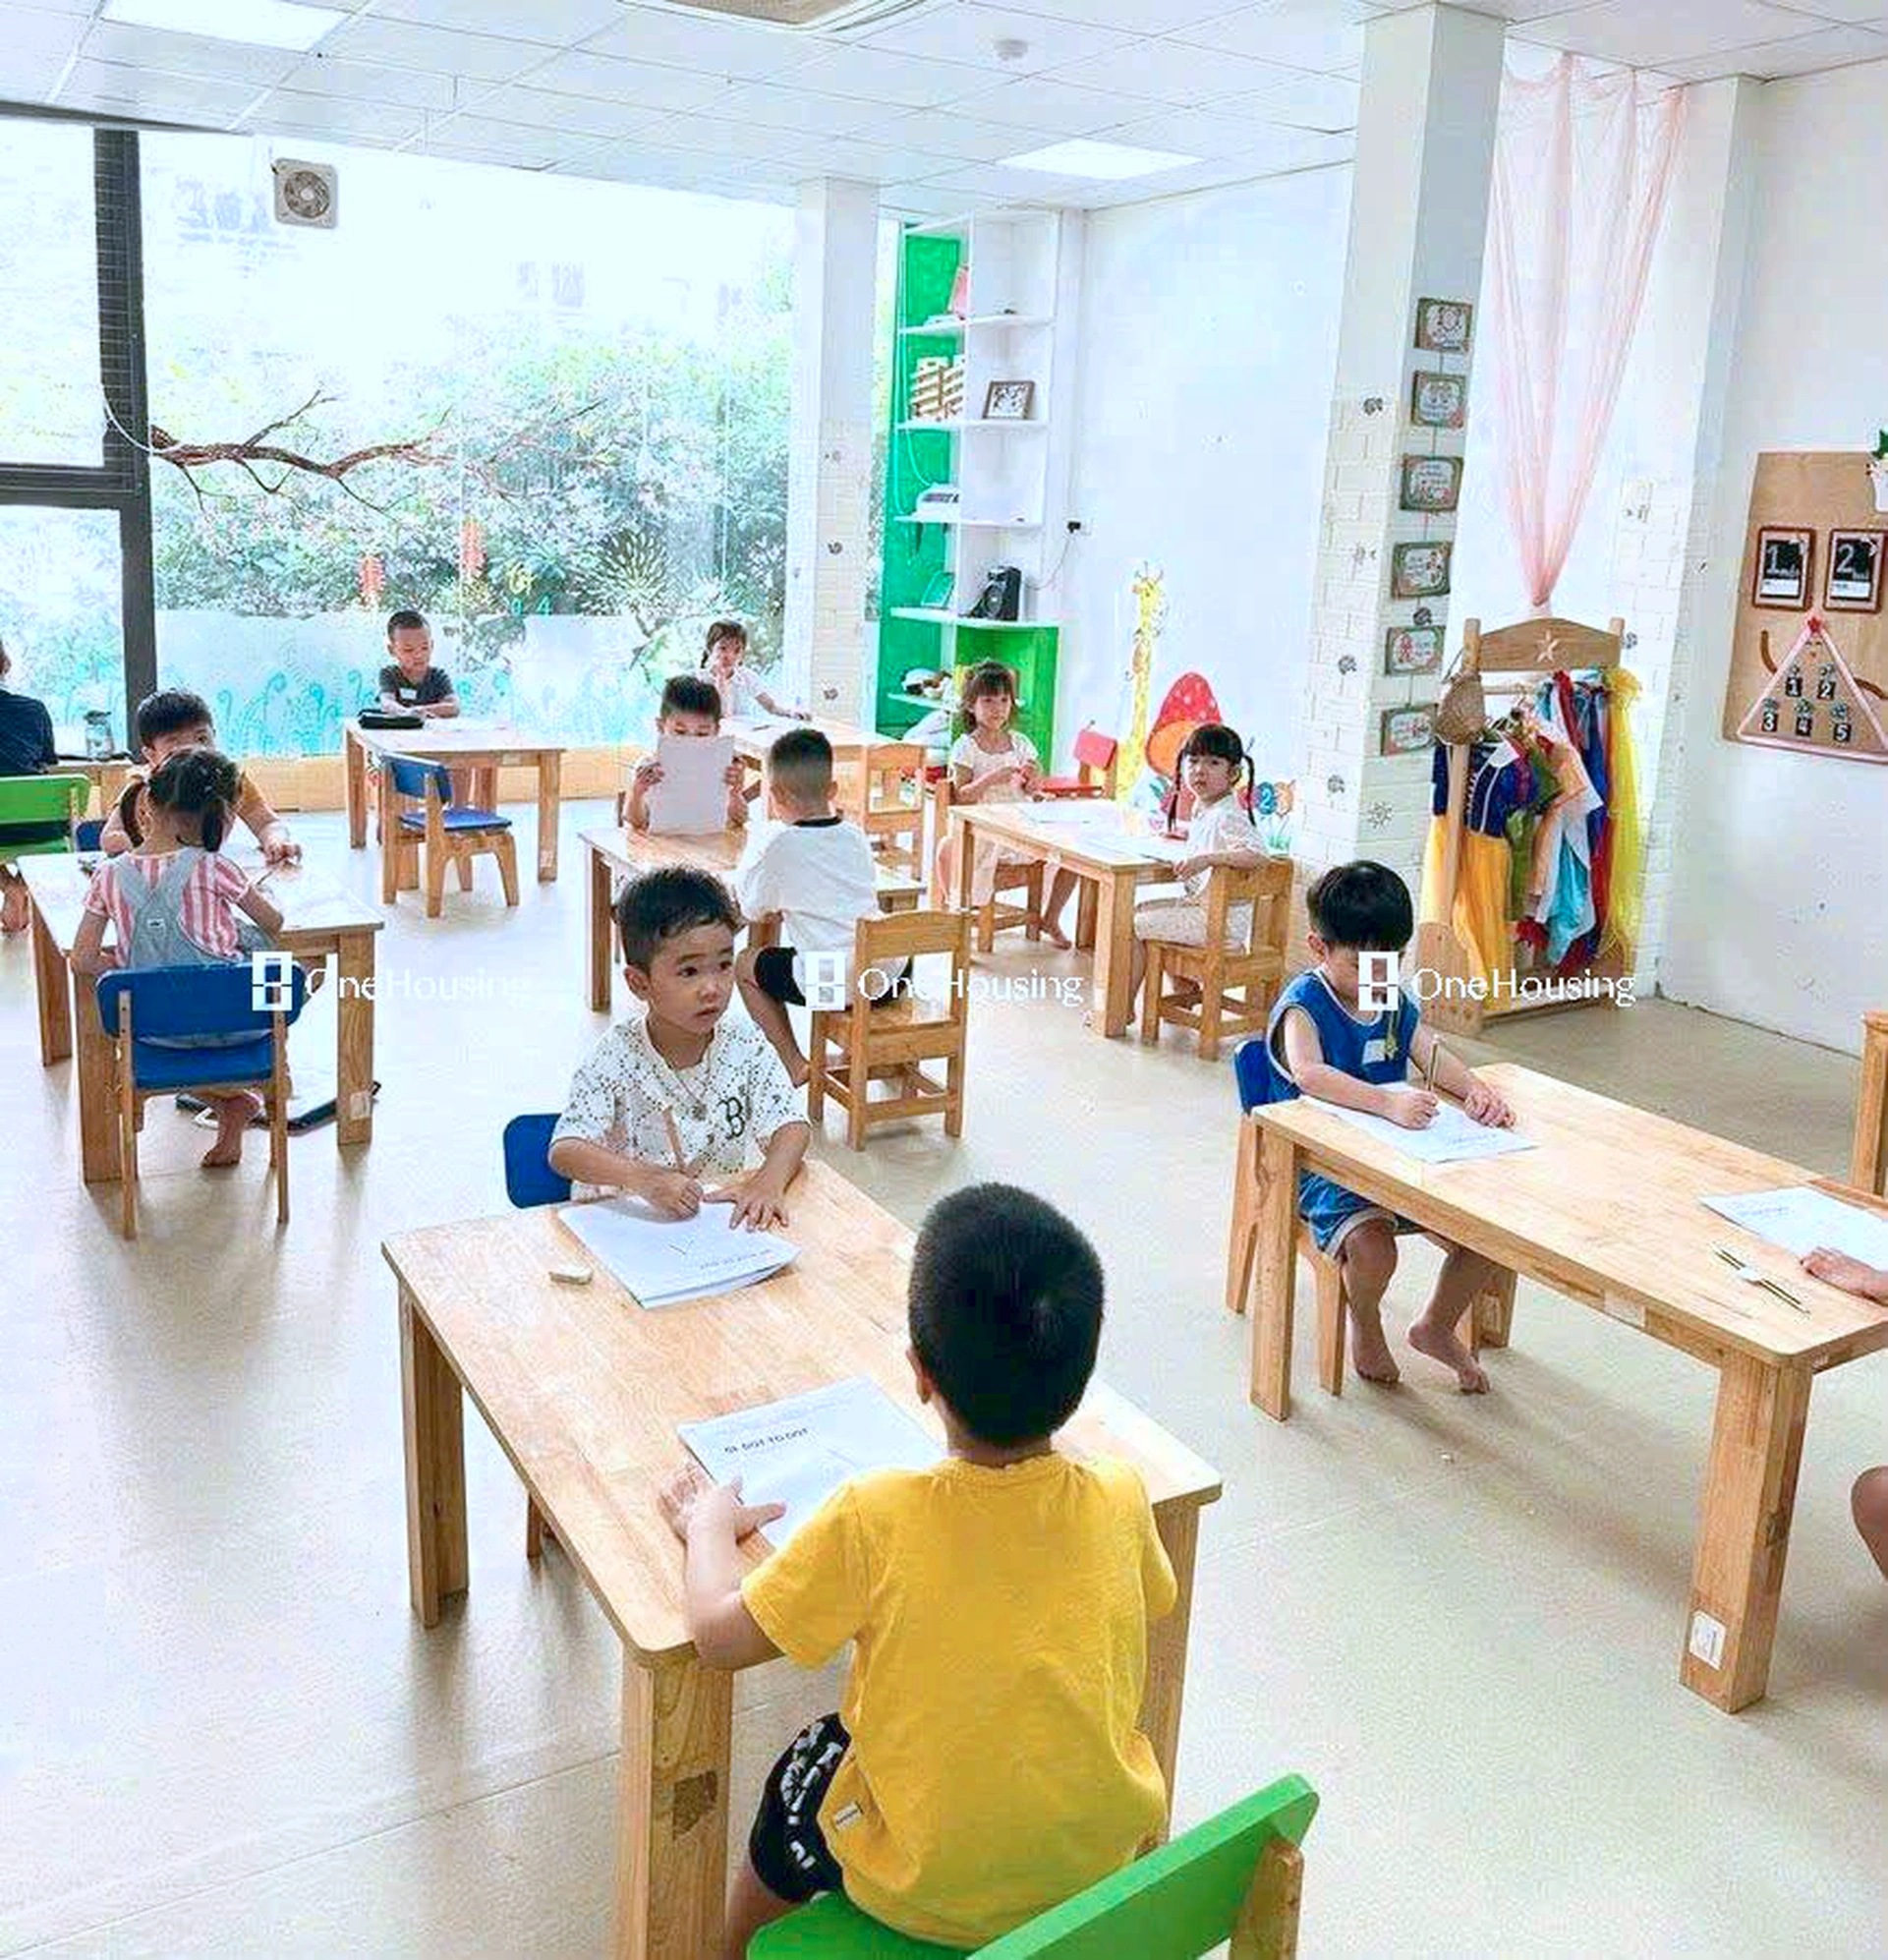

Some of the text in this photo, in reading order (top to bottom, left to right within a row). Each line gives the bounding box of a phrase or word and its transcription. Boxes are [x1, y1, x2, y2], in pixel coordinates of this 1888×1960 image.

[1763, 713, 1775, 731] 3
[1836, 724, 1848, 741] 5
[716, 1097, 745, 1140] B
